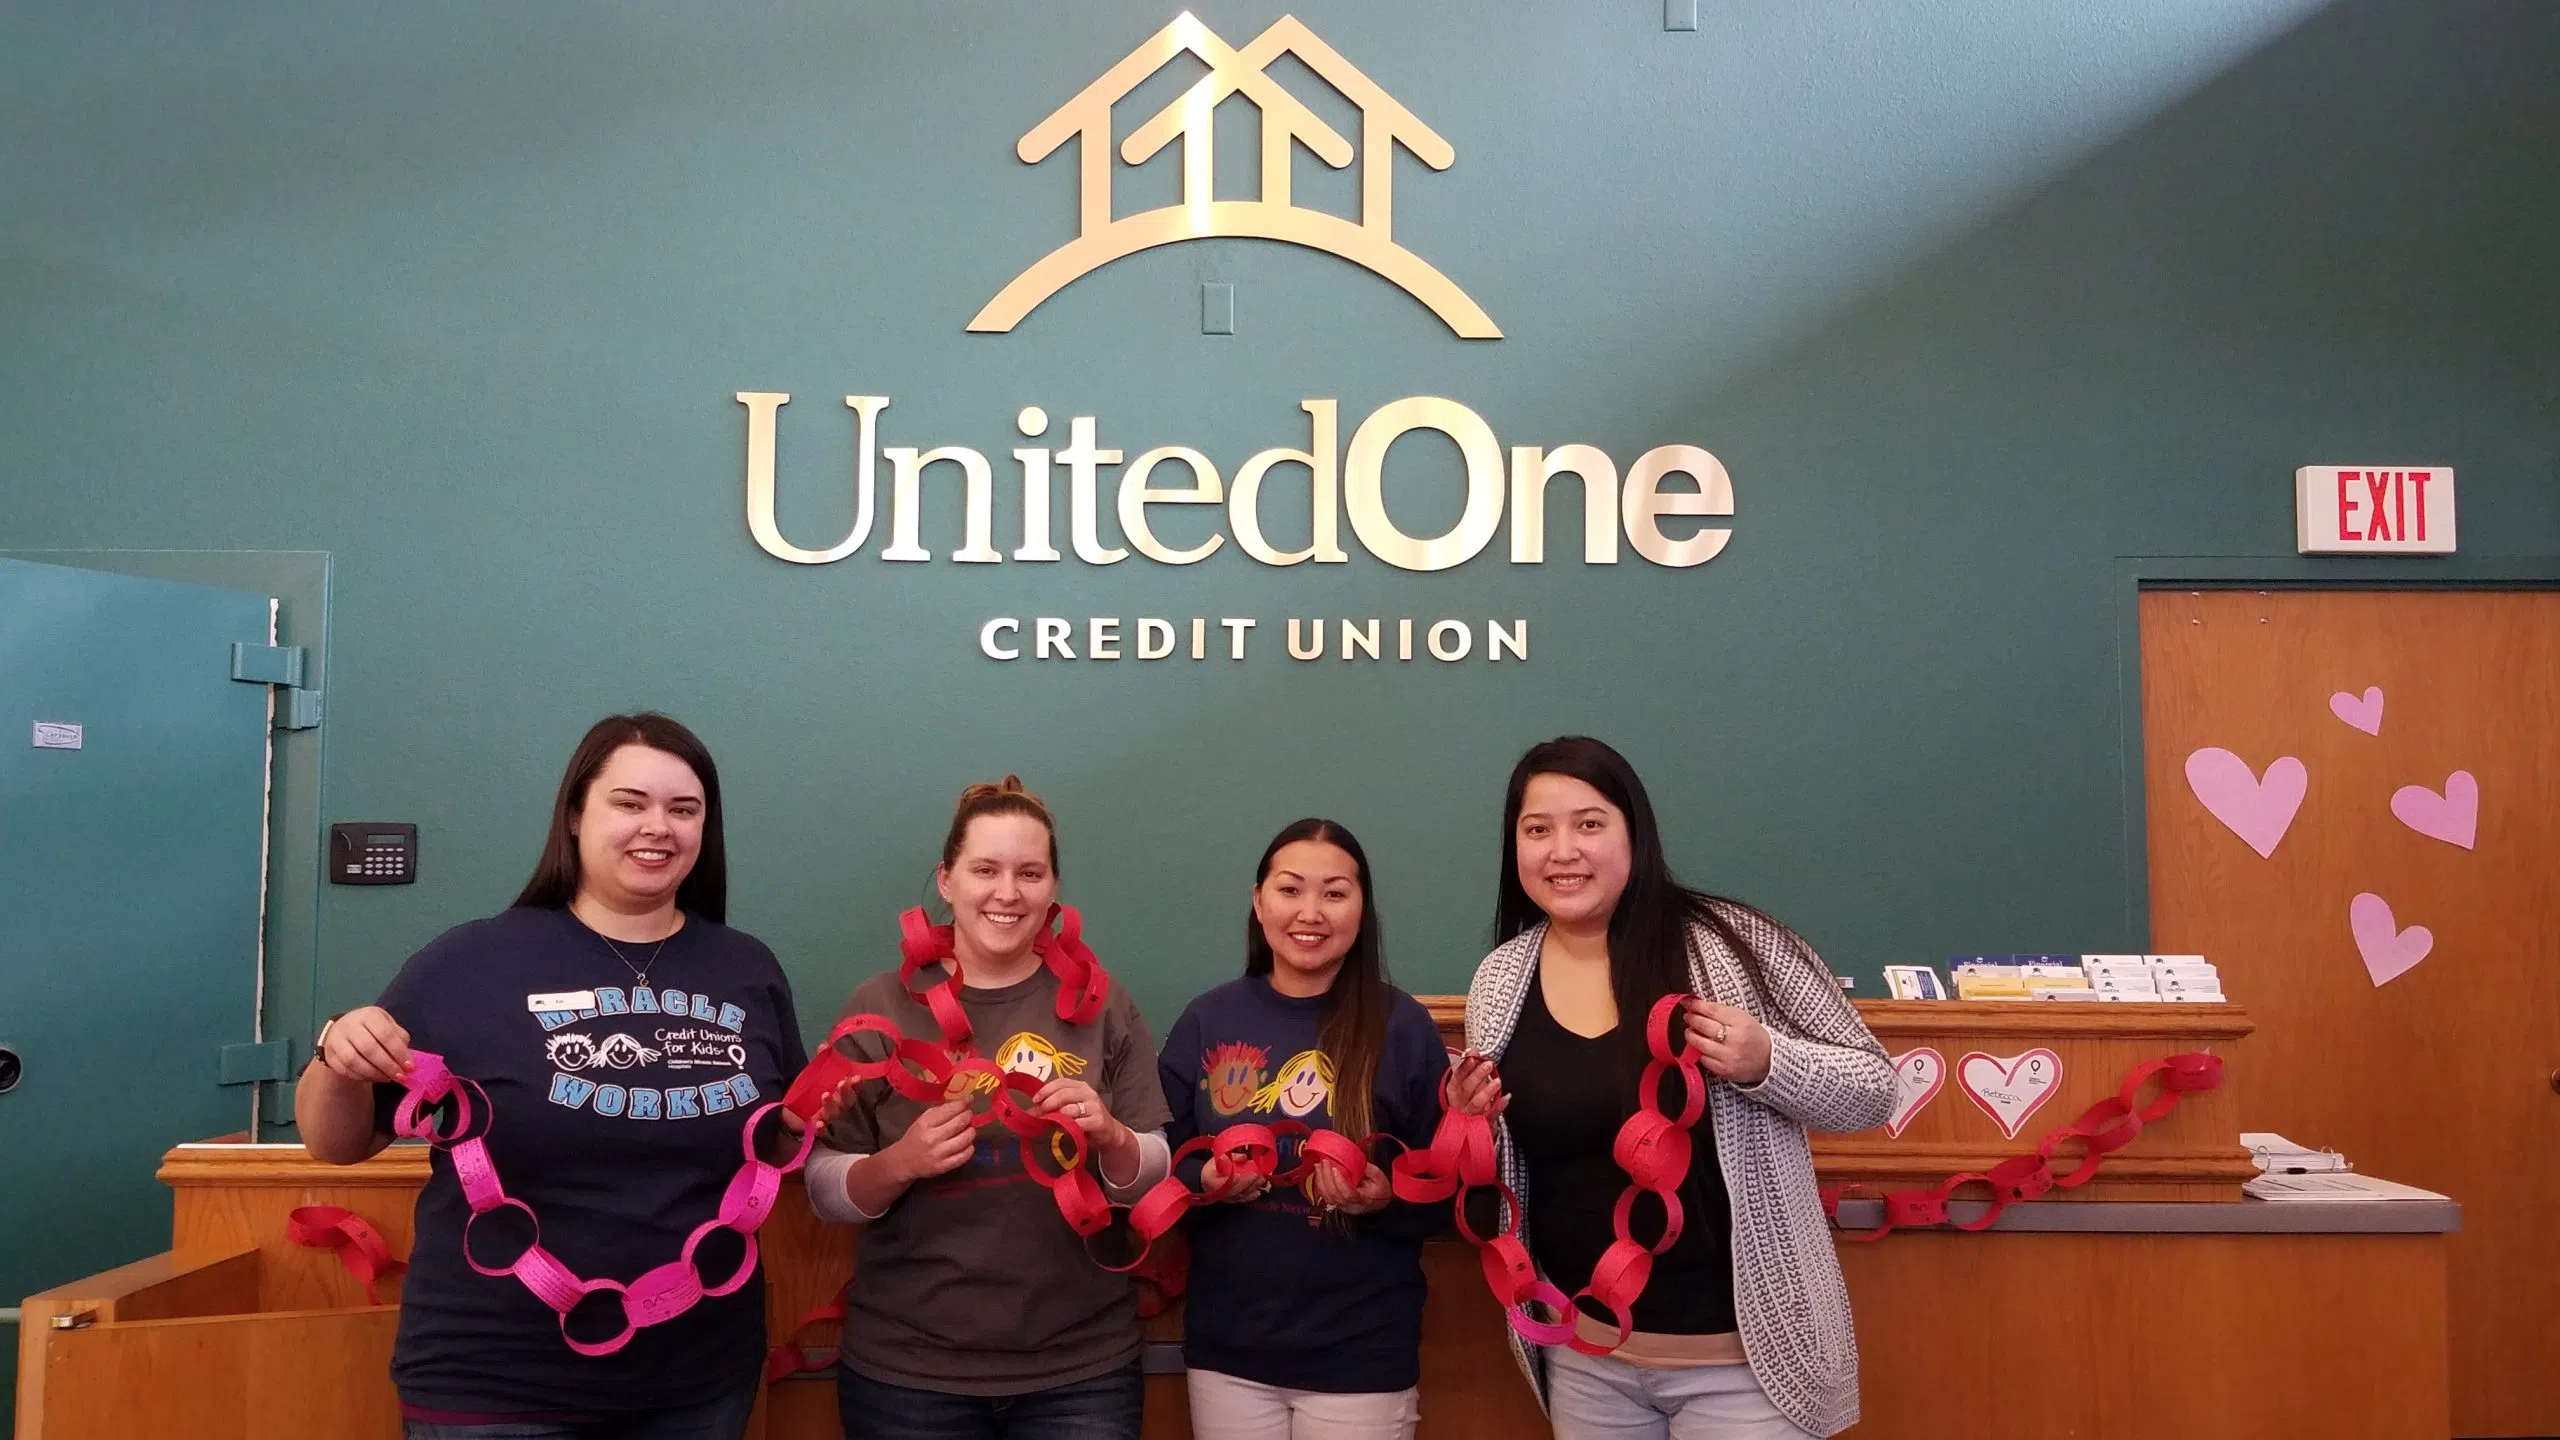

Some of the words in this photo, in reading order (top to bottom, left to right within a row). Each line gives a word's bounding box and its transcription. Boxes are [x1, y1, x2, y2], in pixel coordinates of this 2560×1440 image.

[736, 391, 1735, 571] UnitedOne
[2337, 471, 2431, 541] EXIT
[980, 617, 1256, 661] CREDIT
[1287, 618, 1528, 662] UNION
[655, 1028, 697, 1041] Credit
[700, 1028, 742, 1043] Unions
[661, 1041, 686, 1056] for
[548, 1072, 761, 1120] WORKER
[1981, 1088, 2022, 1102] Rebecca
